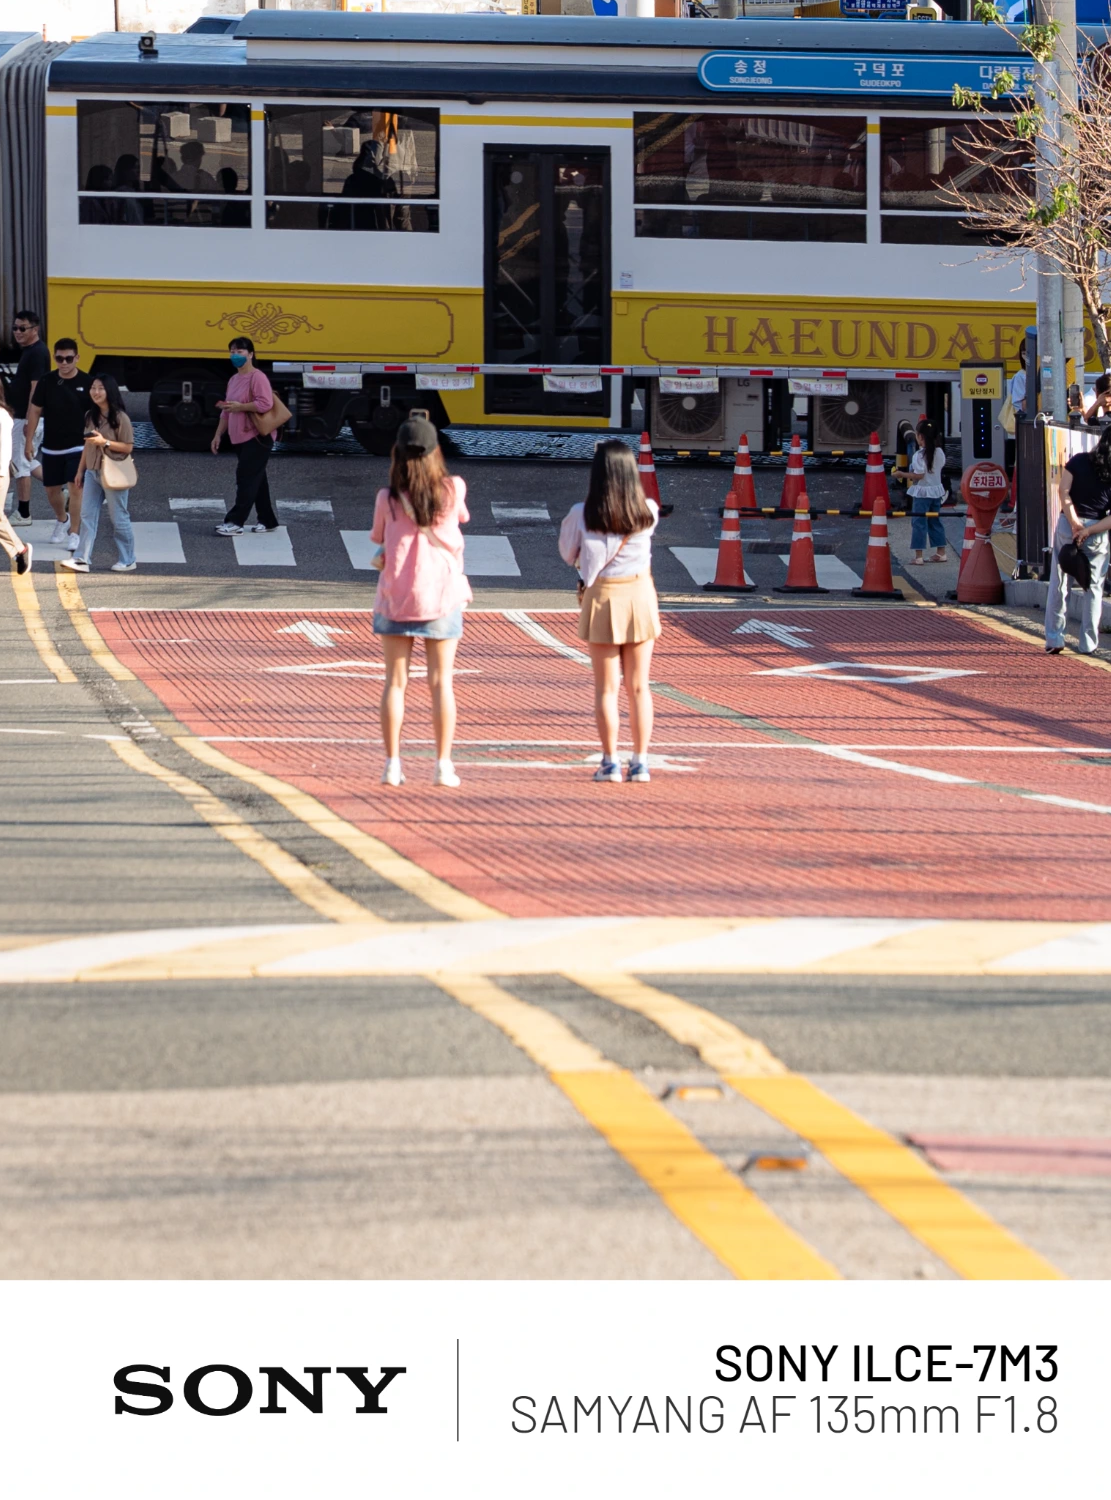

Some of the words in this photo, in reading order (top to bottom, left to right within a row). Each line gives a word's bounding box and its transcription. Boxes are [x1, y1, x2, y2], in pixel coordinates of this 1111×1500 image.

[734, 60, 767, 74] 송정
[853, 62, 905, 77] 구덕포
[703, 314, 1025, 364] HAEUNDAE
[973, 475, 1003, 487] 주차금지
